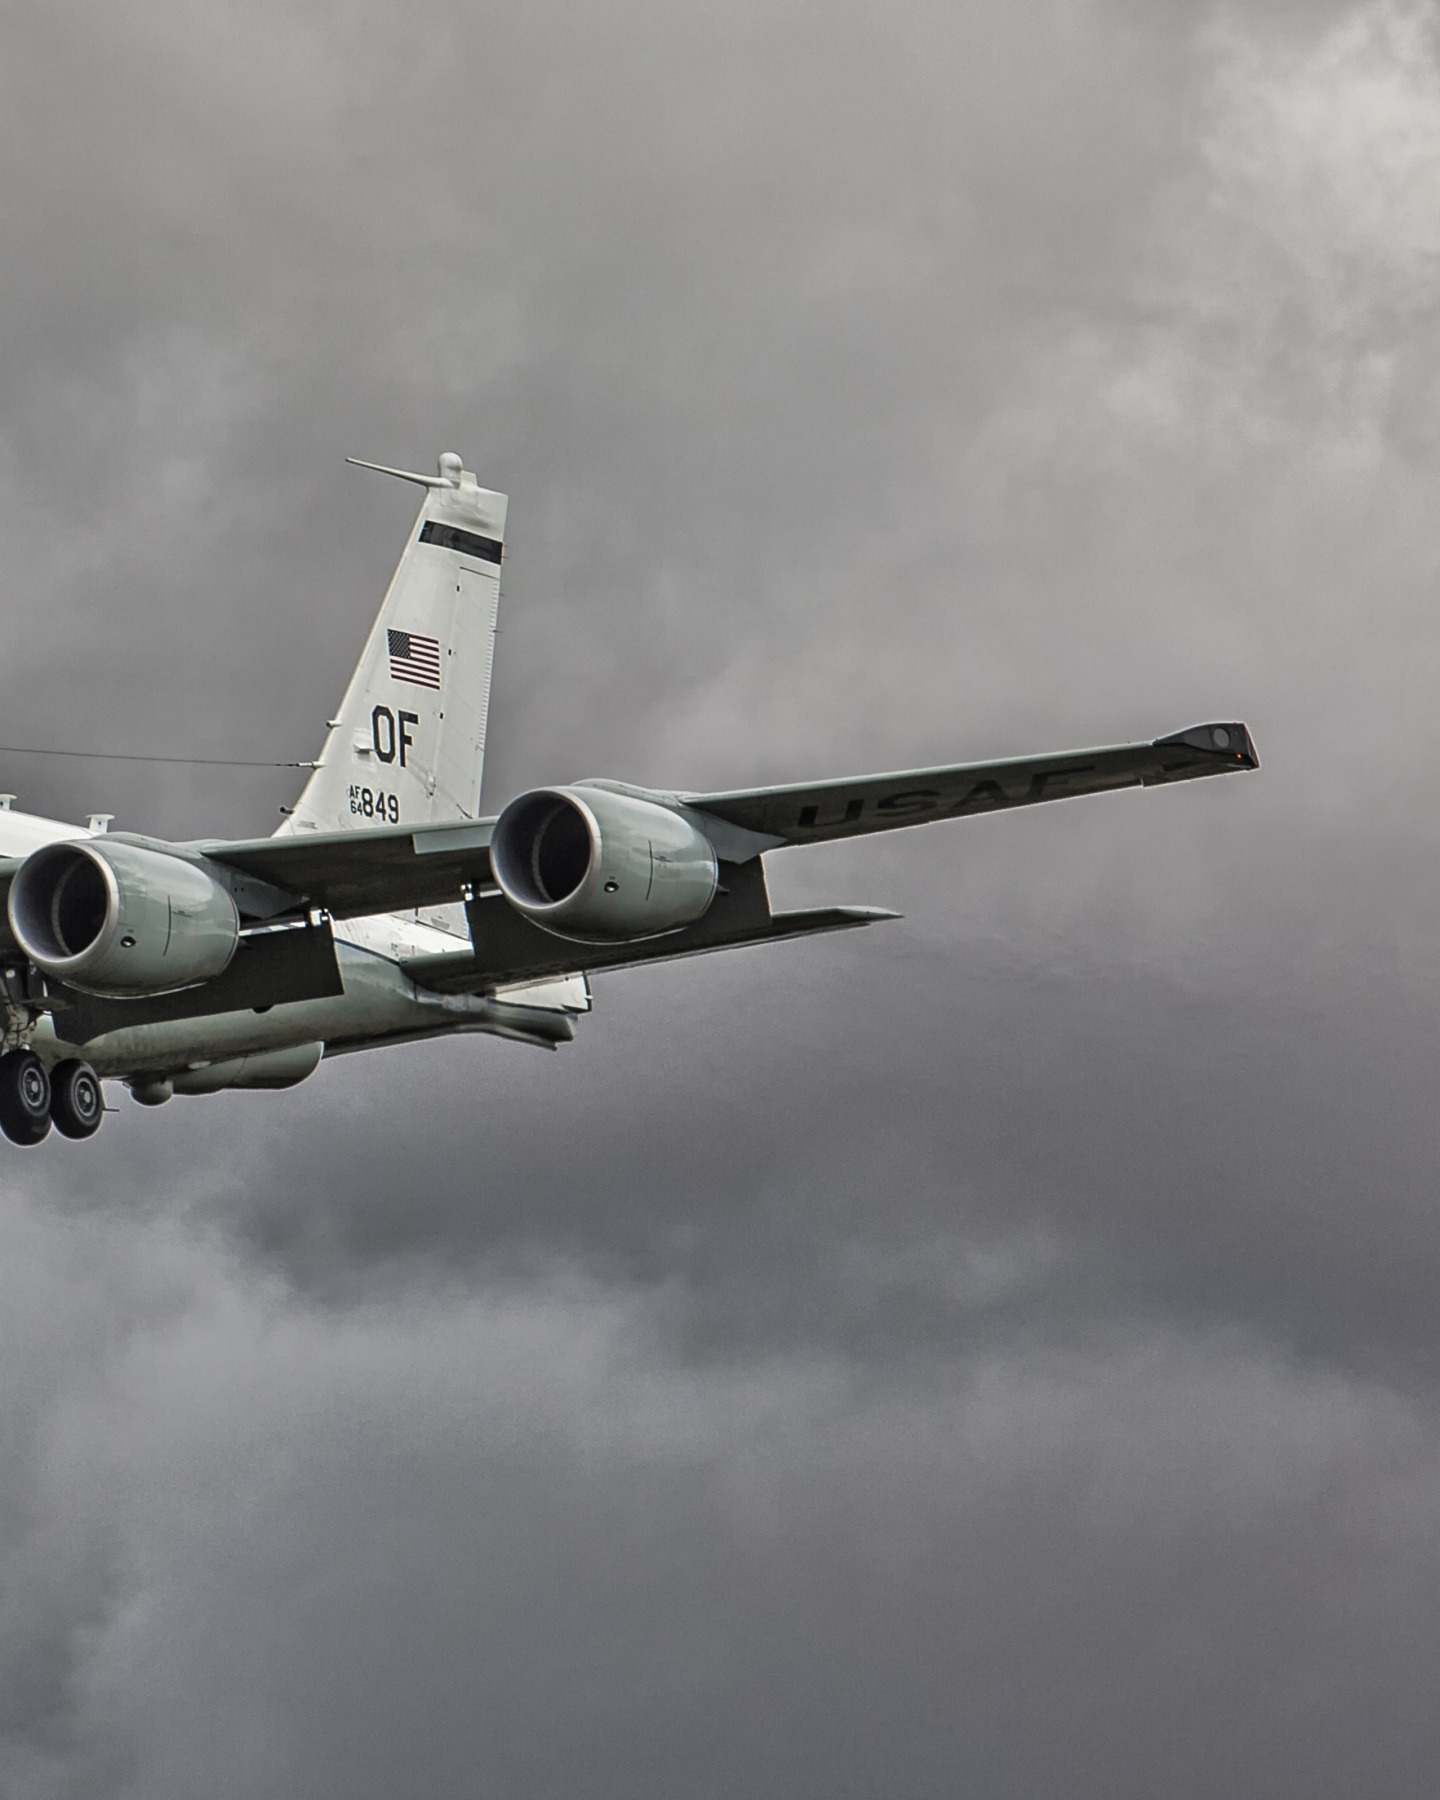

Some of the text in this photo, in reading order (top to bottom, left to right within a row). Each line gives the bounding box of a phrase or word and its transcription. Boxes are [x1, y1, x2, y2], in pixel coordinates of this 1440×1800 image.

[372, 705, 419, 767] OF
[349, 784, 361, 799] AF
[350, 800, 362, 815] 64
[361, 787, 399, 824] 849
[798, 764, 1096, 828] USAF
